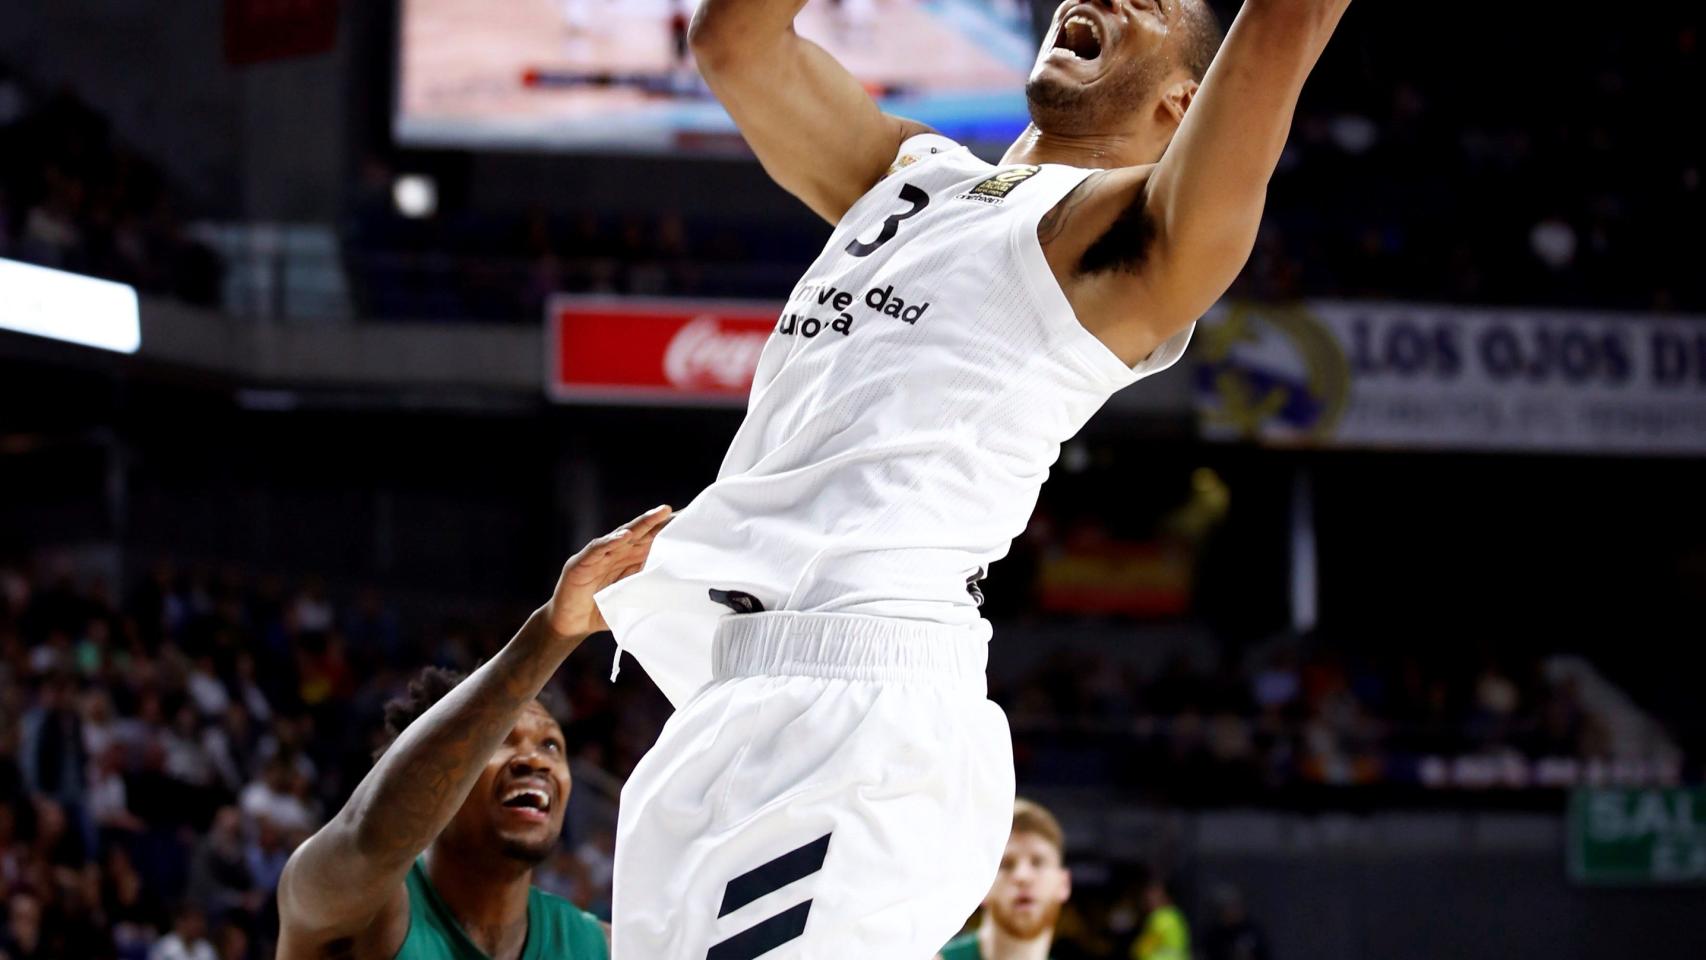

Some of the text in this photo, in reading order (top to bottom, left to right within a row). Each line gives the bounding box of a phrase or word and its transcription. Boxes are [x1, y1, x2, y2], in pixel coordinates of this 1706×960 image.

[845, 183, 930, 258] 3
[1350, 317, 1463, 381] LOS
[1480, 323, 1636, 389] OJOS
